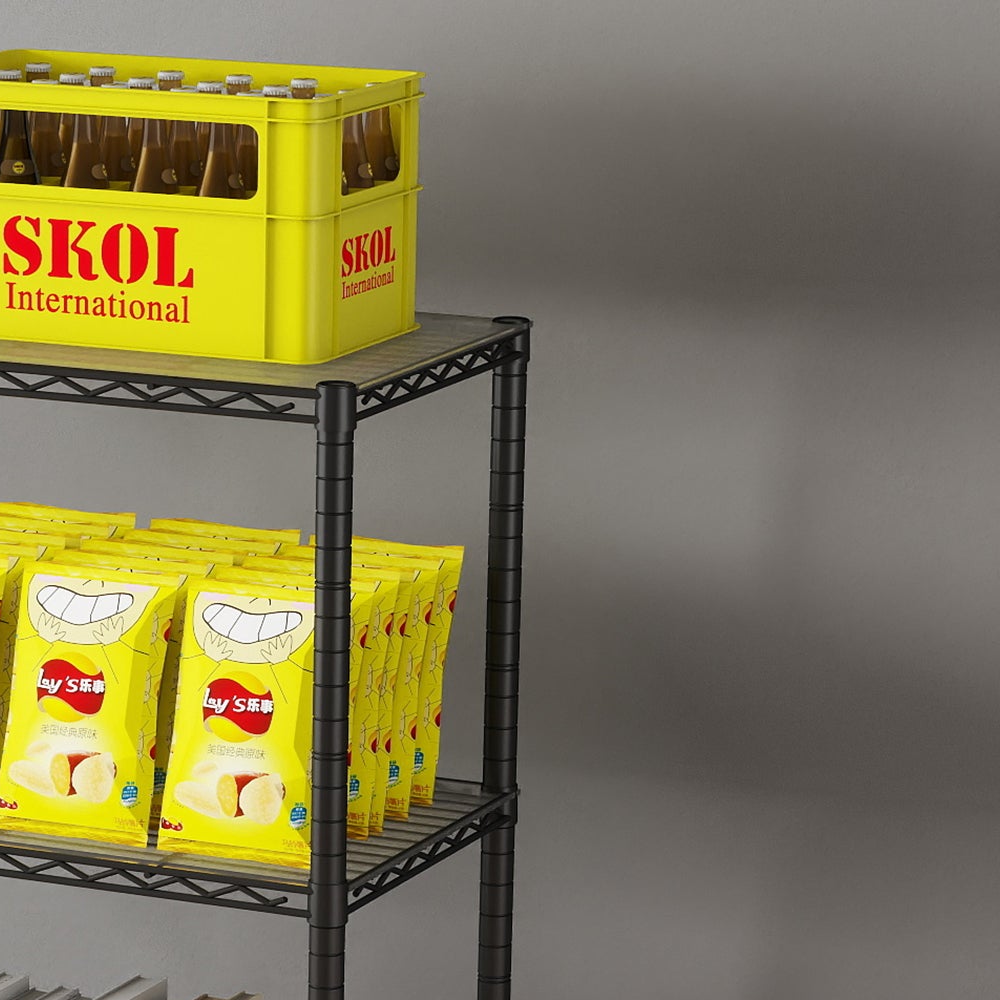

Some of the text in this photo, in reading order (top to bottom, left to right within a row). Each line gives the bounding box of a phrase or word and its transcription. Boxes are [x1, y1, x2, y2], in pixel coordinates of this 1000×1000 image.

[3, 215, 194, 288] SKOL
[341, 226, 396, 278] SKOL
[5, 281, 190, 324] International
[342, 265, 394, 300] International
